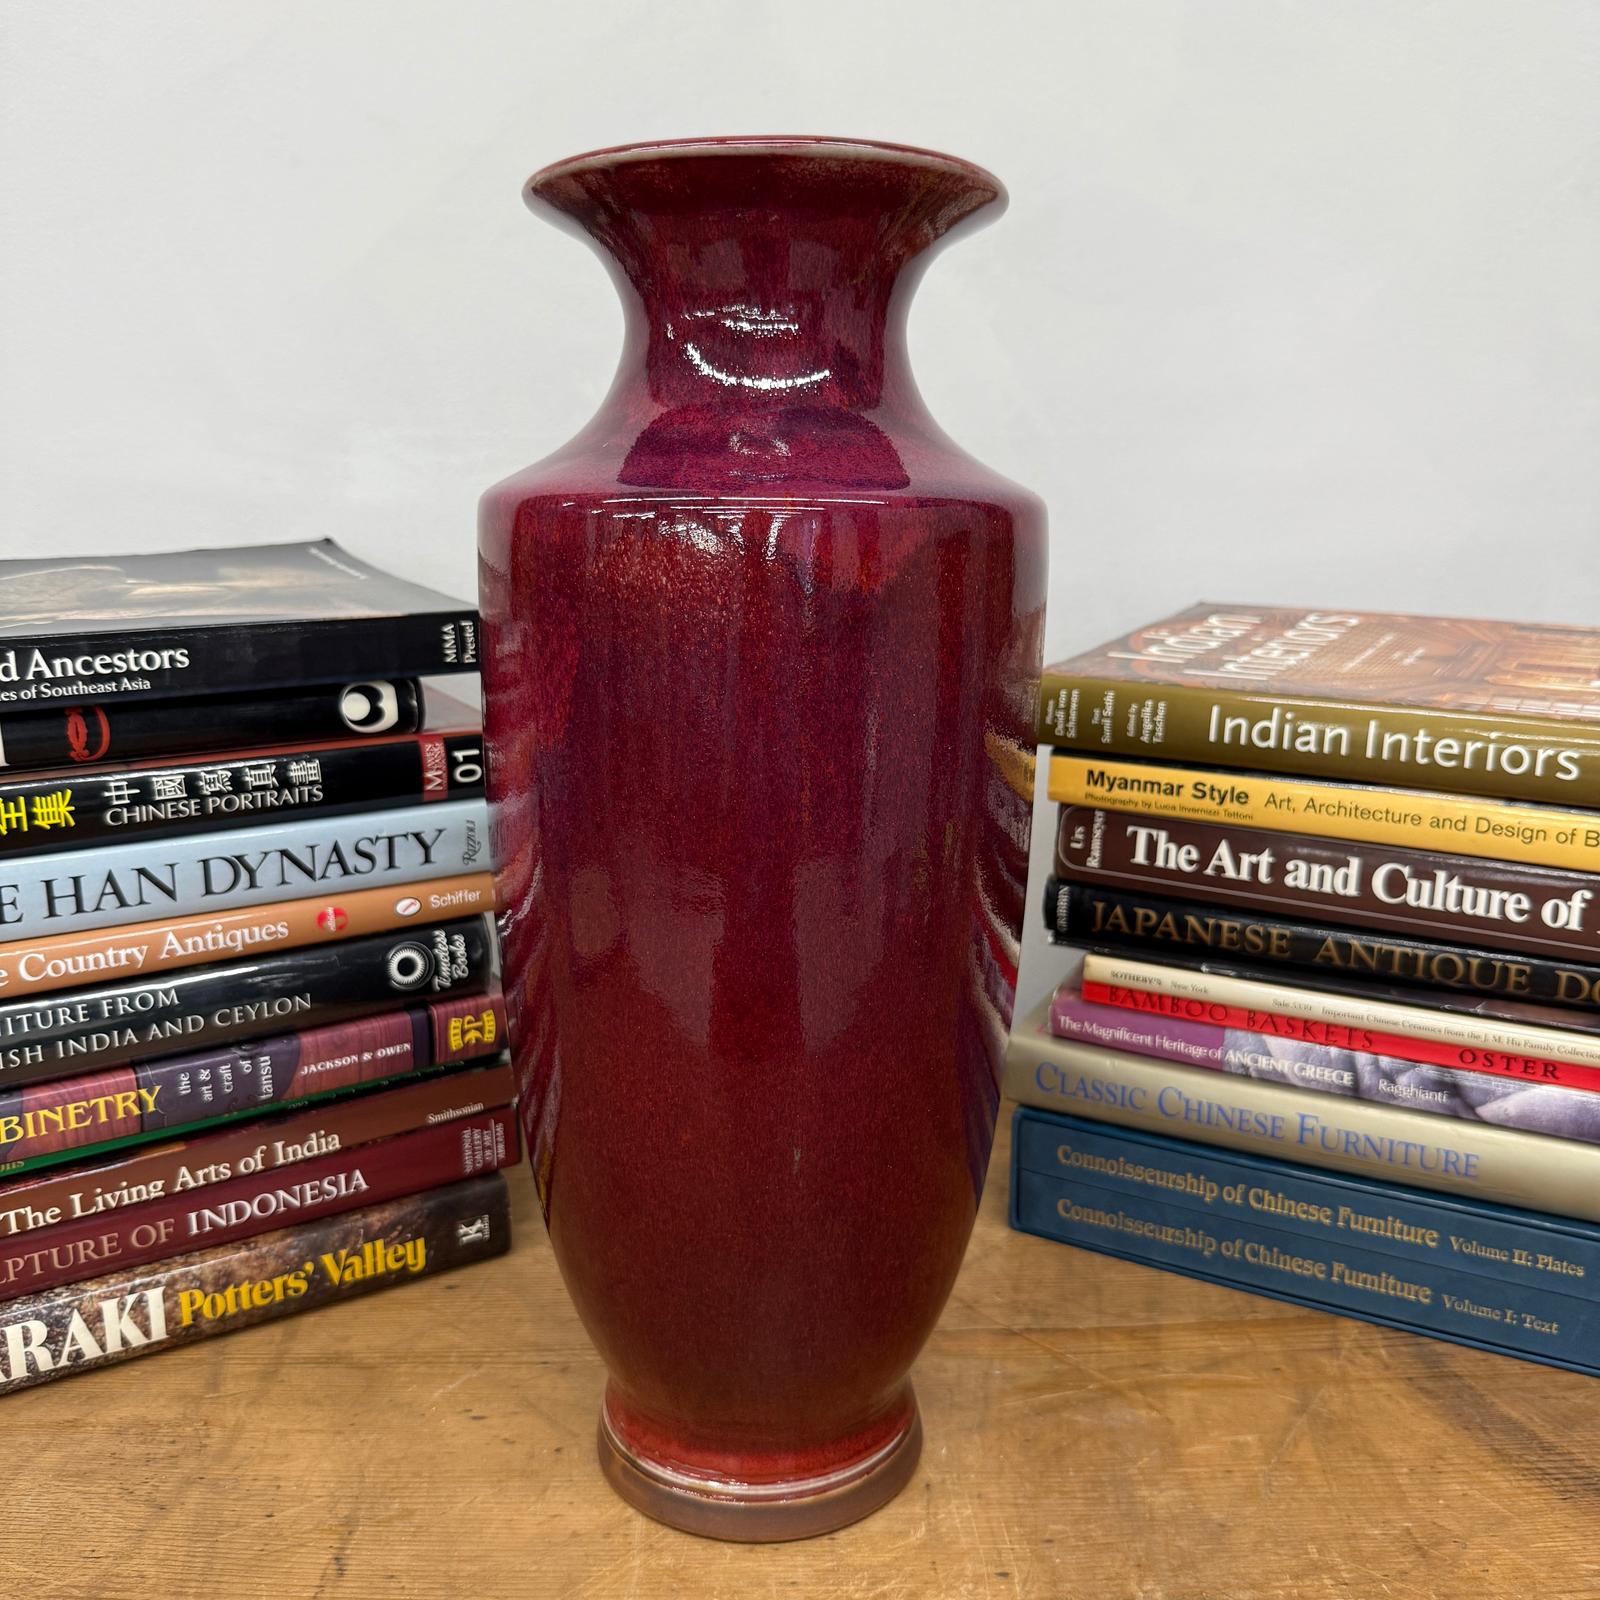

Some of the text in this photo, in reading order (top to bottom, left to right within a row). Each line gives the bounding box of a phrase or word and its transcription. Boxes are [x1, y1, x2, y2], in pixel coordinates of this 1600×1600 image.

[442, 623, 457, 663] MMA
[459, 620, 476, 663] Prestel
[1107, 613, 1263, 664] Indian
[1183, 612, 1360, 681] Interiors
[20, 684, 37, 700] of
[41, 680, 118, 698] Southeast
[120, 676, 151, 691] Asia
[26, 648, 190, 680] Ancestors
[1140, 699, 1153, 744] Angelika
[1153, 701, 1167, 744] Taschen
[1208, 704, 1582, 781] Indian Interiors
[452, 748, 482, 784] 01
[105, 784, 323, 827] CHINESE PORTRAITS
[1085, 792, 1139, 808] Photography
[1141, 800, 1152, 809] by
[1154, 803, 1176, 812] Luca
[1086, 769, 1185, 798] Myanmar
[1191, 782, 1250, 806] Style
[1264, 792, 1295, 813] Art,
[1303, 797, 1422, 826] Architecture
[1429, 815, 1466, 832] and
[1475, 816, 1547, 845] Design
[1556, 827, 1577, 845] of
[40, 862, 180, 920] HAN
[197, 828, 448, 897] DYNASTY
[1126, 825, 1594, 931] The Art and Culture of
[430, 890, 481, 909] Schiffer
[18, 945, 148, 982] Country
[160, 921, 289, 960] Antiques
[431, 928, 451, 993] Timeless
[451, 933, 469, 980] Books
[1091, 900, 1291, 956] JAPANESE
[1314, 935, 1532, 993] ANTIQUE
[1555, 970, 1600, 1006] D
[57, 1025, 139, 1059] INDIA
[149, 1014, 204, 1040] AND
[214, 992, 312, 1028] CEYLON
[102, 988, 180, 1019] FROM
[1110, 970, 1162, 986] SOTHEBY'S
[1170, 980, 1190, 991] New
[1190, 983, 1209, 994] York
[1321, 1006, 1364, 1021] Important
[1366, 1014, 1400, 1027] Chinese
[1401, 1018, 1442, 1034] Ceramics
[1444, 1026, 1466, 1039] from
[1467, 1029, 1482, 1040] the
[1506, 1037, 1520, 1047] Hu
[1523, 1040, 1553, 1052] Family
[1108, 986, 1560, 1080] BAMBOO BASKETS OSTER
[219, 1063, 233, 1094] craft
[240, 1060, 252, 1073] of
[258, 1055, 273, 1101] tansu
[300, 1042, 411, 1076] JACKSON & OWEN
[1059, 1015, 1448, 1103] The Magnificent Heritage of ANCIENT GREECE Ragghianti
[177, 1072, 193, 1096] the
[200, 1068, 214, 1103] art &
[427, 1102, 484, 1124] Smithsonian
[1035, 1061, 1480, 1179] CLASSIC CHINESE FURNITURE
[0, 1130, 341, 1235] The Living Arts of India
[131, 1218, 175, 1248] OF
[187, 1169, 369, 1236] INDONESIA
[1056, 1144, 1219, 1203] Connoisseurship
[1222, 1183, 1246, 1204] of
[1248, 1187, 1333, 1224] Chinese
[1336, 1205, 1440, 1248] Furniture
[1448, 1235, 1509, 1262] Volume
[1536, 1253, 1585, 1277] Plates
[178, 1262, 313, 1328] Potters'
[321, 1237, 427, 1286] Valley
[1056, 1198, 1217, 1257] Connoisseurship
[1220, 1238, 1243, 1259] of
[1243, 1242, 1327, 1280] Chinese
[1330, 1260, 1432, 1305] Furniture
[1441, 1293, 1501, 1321] Volume
[1521, 1313, 1559, 1335] Text
